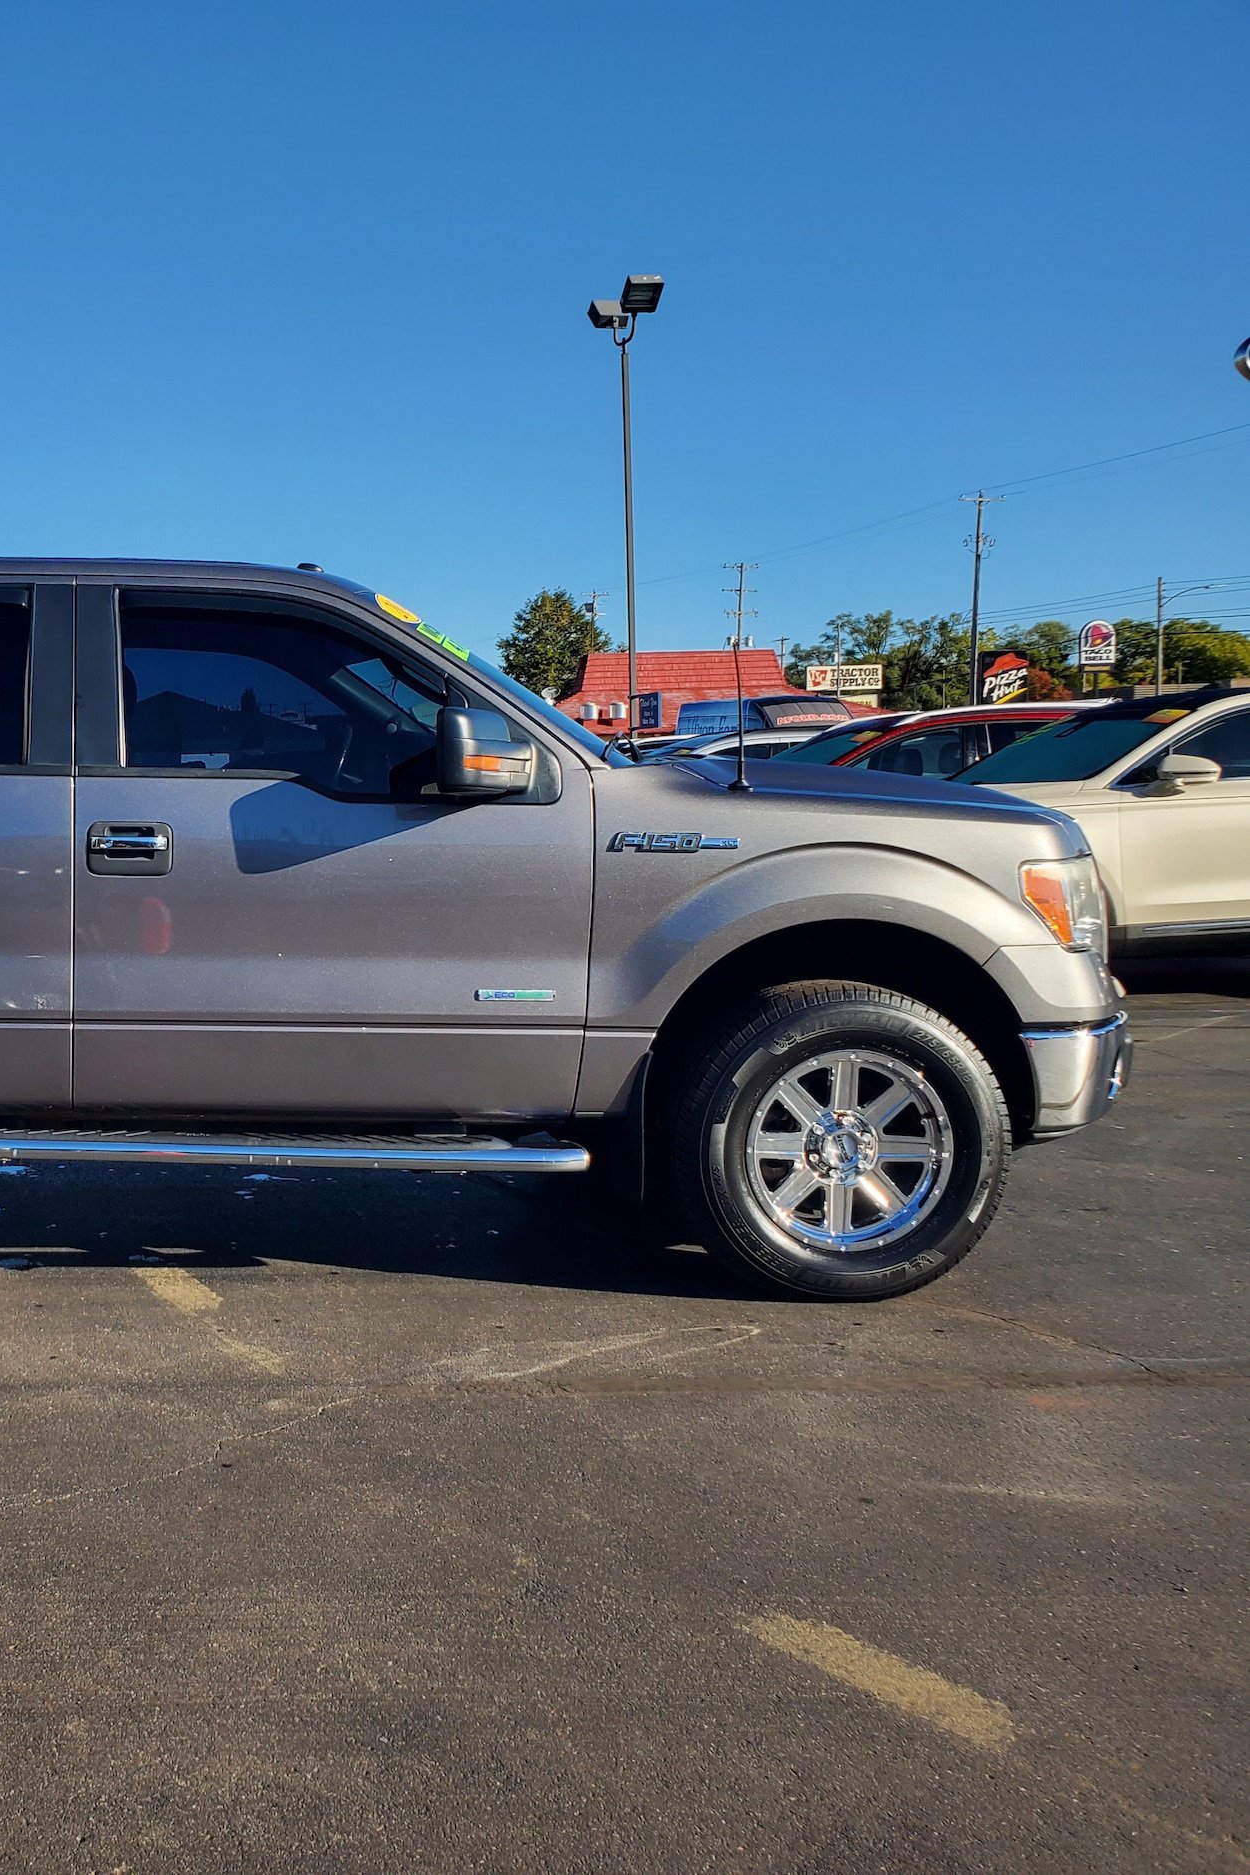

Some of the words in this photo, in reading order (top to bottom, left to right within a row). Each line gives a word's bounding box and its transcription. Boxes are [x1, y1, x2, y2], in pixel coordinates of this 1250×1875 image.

[829, 677, 867, 688] SUPPLY
[830, 667, 880, 677] TRACTOR
[983, 668, 1029, 698] Pizza
[990, 678, 1026, 702] Hut
[606, 831, 702, 854] F-150
